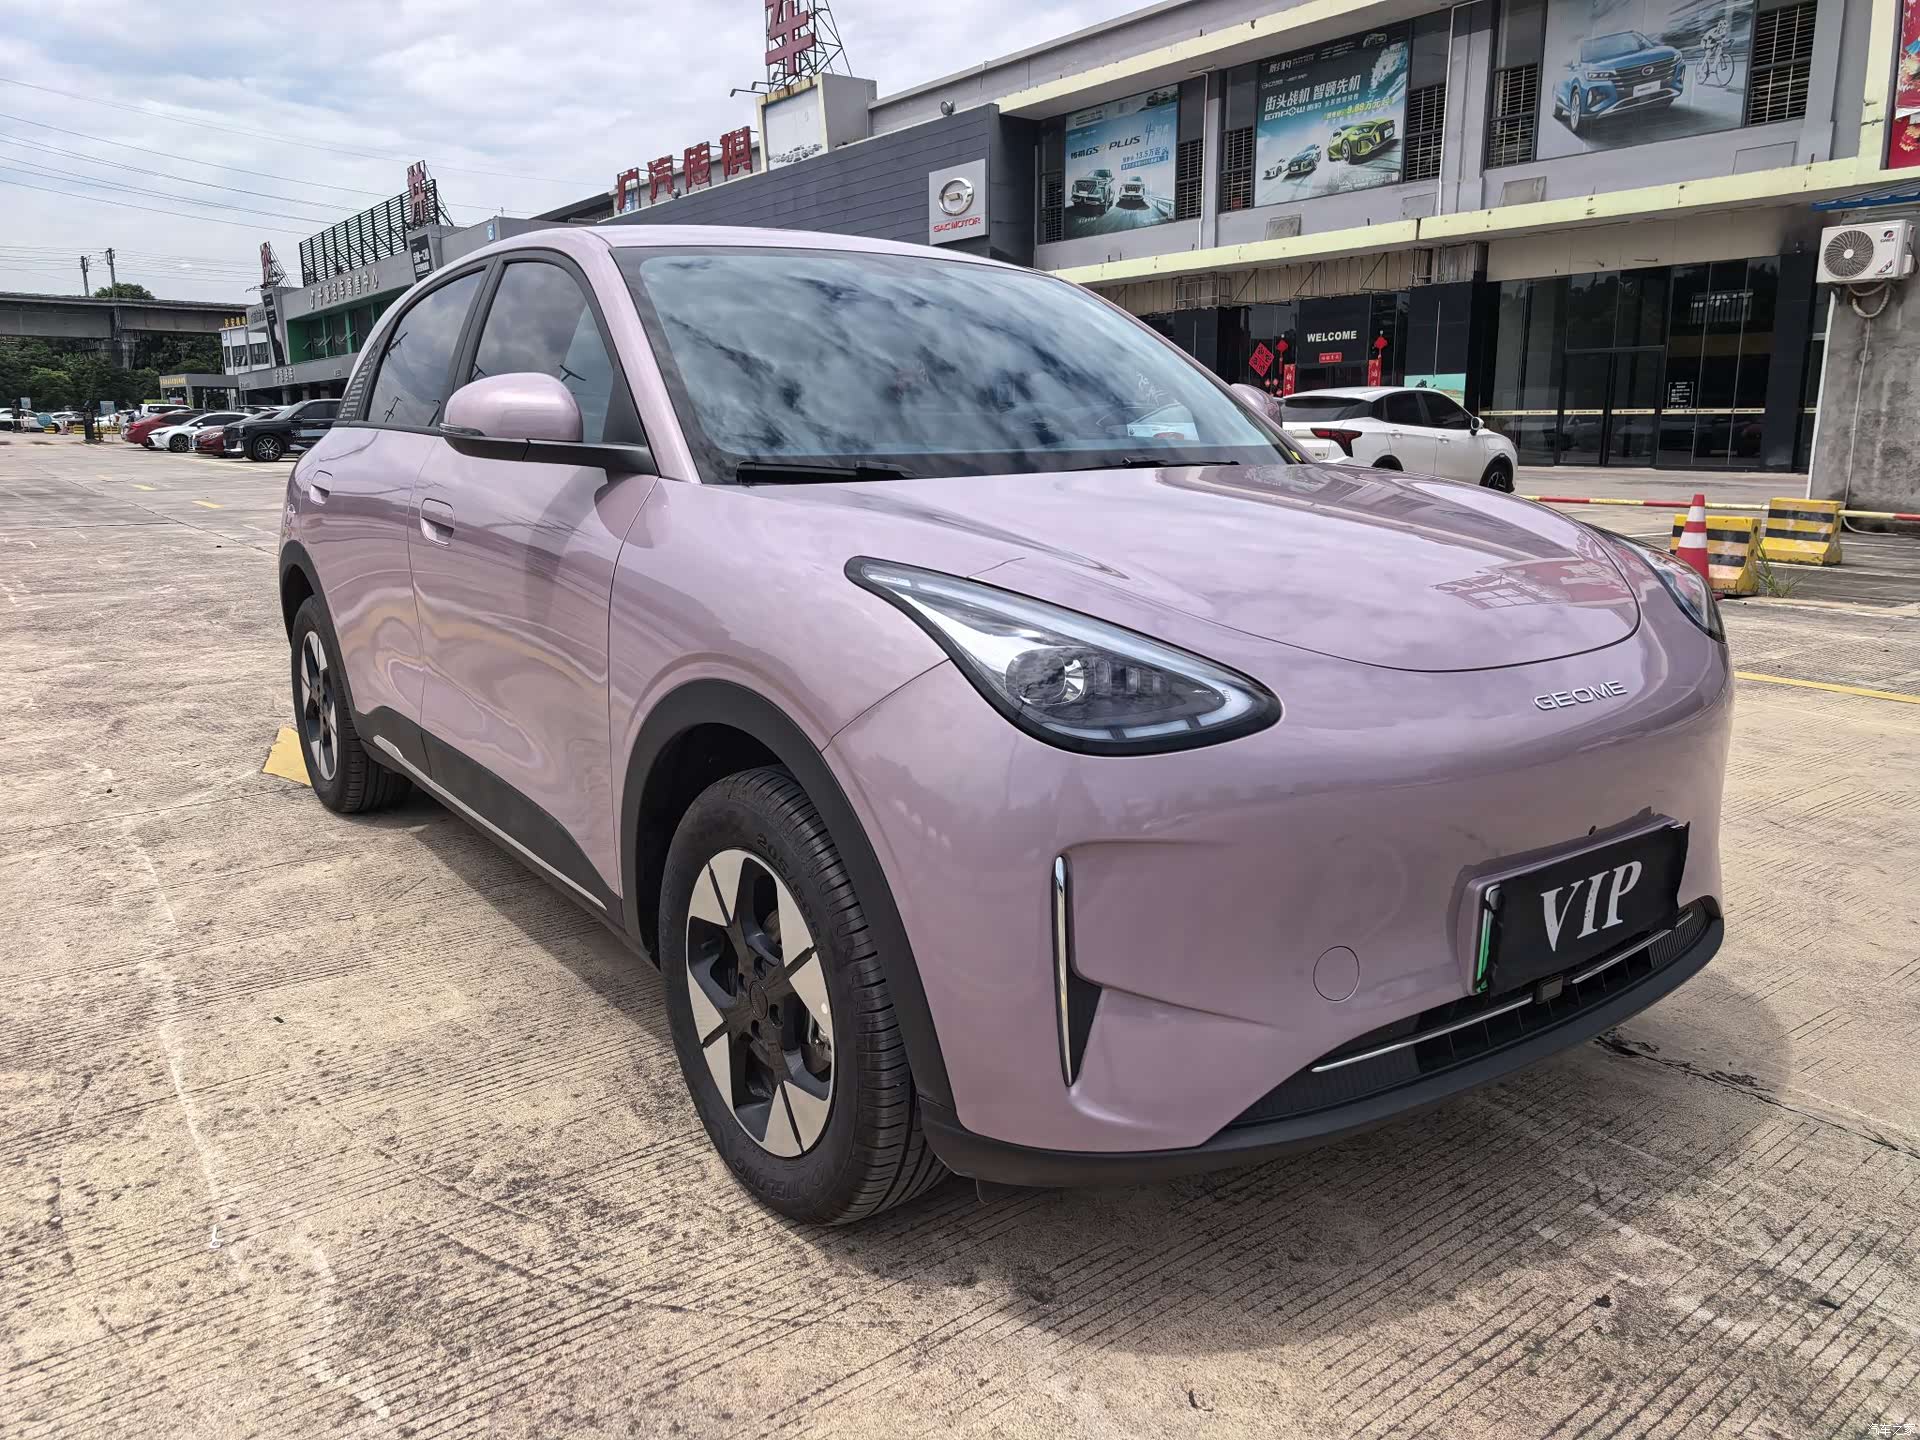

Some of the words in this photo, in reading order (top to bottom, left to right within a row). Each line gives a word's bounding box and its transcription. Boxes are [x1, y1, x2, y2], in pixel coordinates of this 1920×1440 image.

[1264, 87, 1310, 113] 街头战机
[1313, 73, 1362, 101] 智领先机
[1108, 135, 1141, 151] PLUS
[617, 126, 752, 211] 广汽传祺
[1307, 330, 1357, 343] WELCOME
[1533, 680, 1628, 710] GEOME
[1541, 860, 1643, 952] VIP
